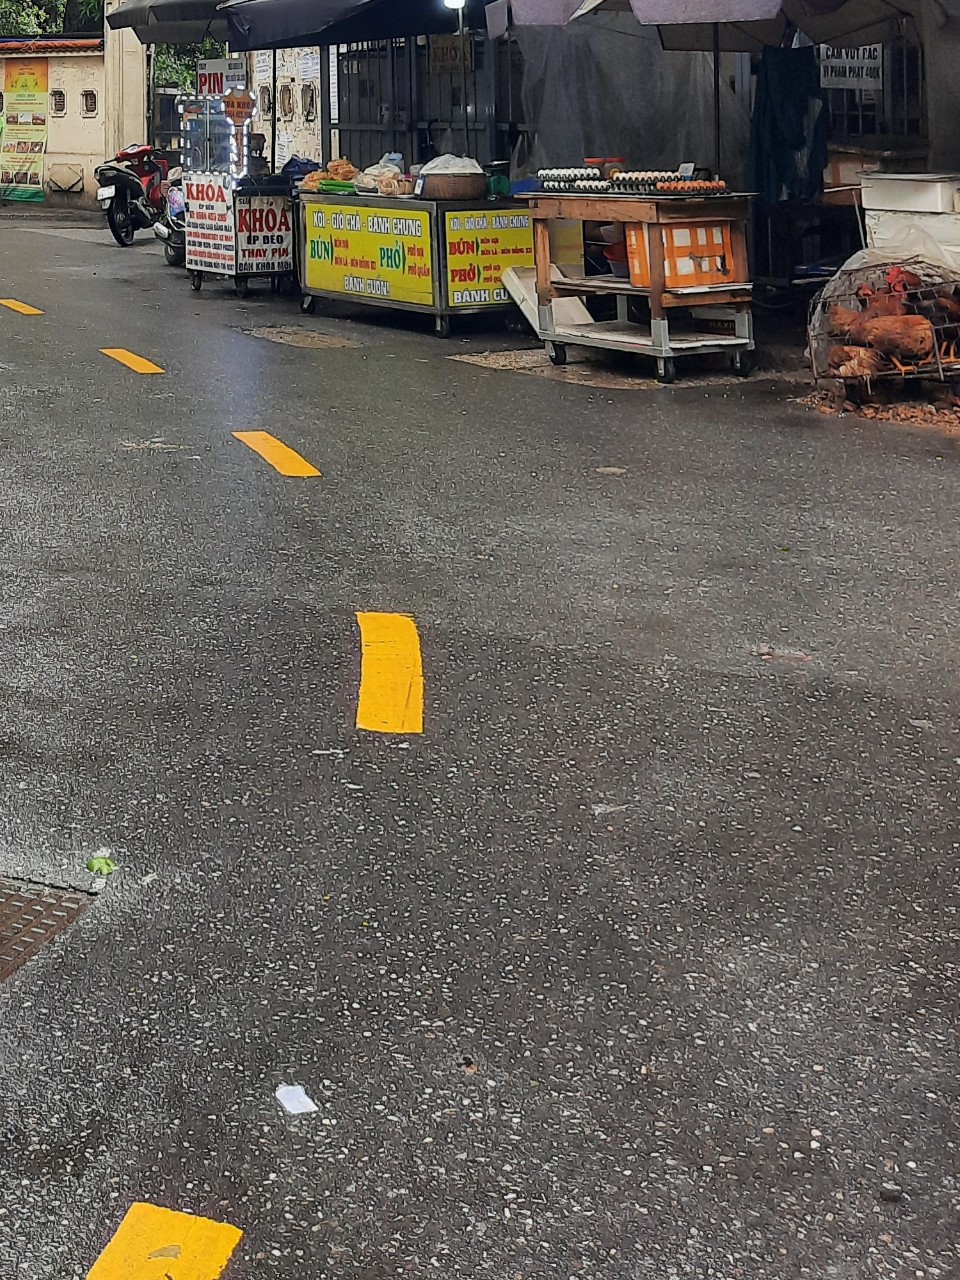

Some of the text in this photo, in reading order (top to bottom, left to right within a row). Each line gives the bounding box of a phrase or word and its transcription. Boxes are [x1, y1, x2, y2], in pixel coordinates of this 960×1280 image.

[199, 72, 223, 94] PIN
[186, 179, 226, 202] KHÓA
[238, 201, 291, 232] KHÓA
[313, 209, 325, 227] XÔI
[332, 210, 344, 230] GIÒ
[346, 210, 361, 231] CHẢ
[367, 213, 390, 234] BÁNH
[449, 216, 460, 231] XÔI
[465, 214, 474, 230] GIÒ
[476, 213, 487, 229] CHẢ
[492, 214, 509, 229] BÁNH
[241, 249, 267, 258] THAY
[271, 248, 289, 257] PIN
[310, 235, 330, 260] BÚN
[379, 240, 400, 269] PHỞ
[448, 238, 475, 255] BÚN
[344, 273, 364, 293] BÁNH
[451, 263, 476, 282] PHỞ
[453, 288, 510, 303] BÁNH CU
